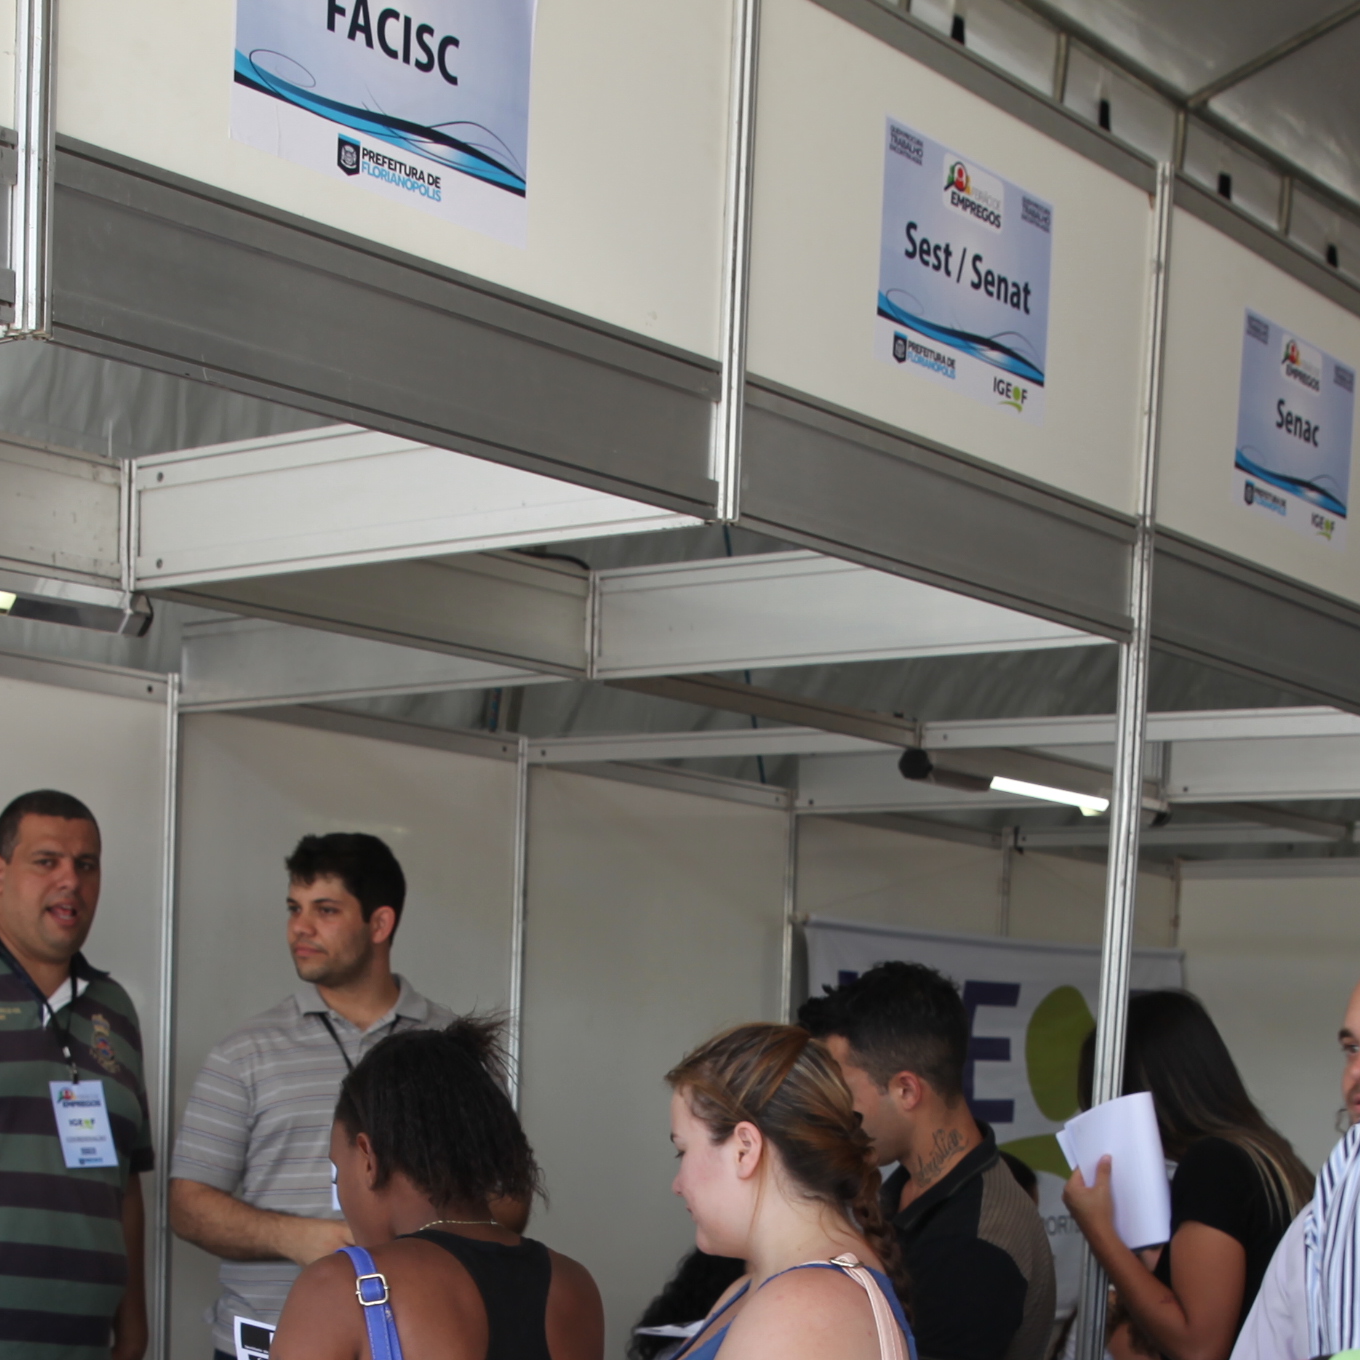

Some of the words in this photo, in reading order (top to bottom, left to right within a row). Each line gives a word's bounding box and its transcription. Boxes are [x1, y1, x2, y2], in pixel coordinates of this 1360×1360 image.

[327, 0, 460, 86] FACISC
[361, 146, 426, 184] PREFEITURA
[427, 172, 442, 190] DE
[950, 190, 1001, 229] EMPREGOS
[904, 220, 953, 278] Sest
[956, 246, 967, 284] /
[970, 253, 1032, 316] Senat
[992, 376, 1028, 405] IGEOF
[1275, 398, 1320, 448] Senac
